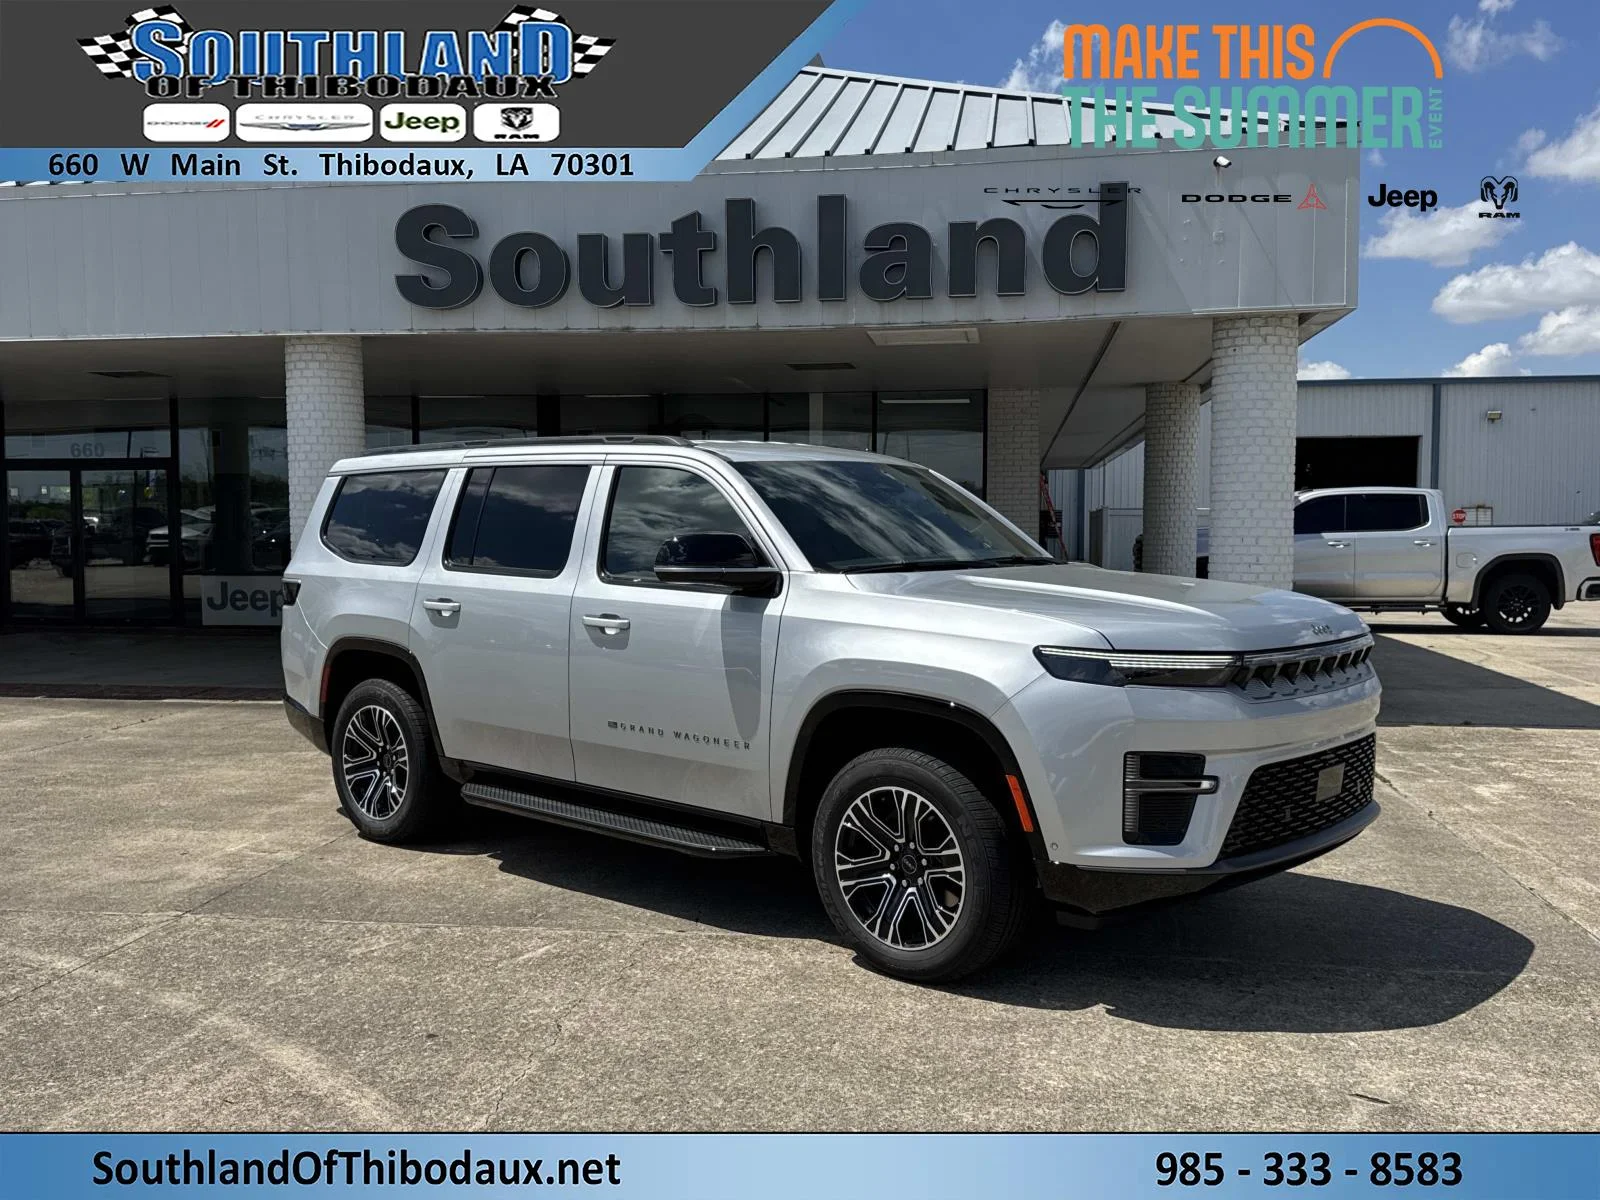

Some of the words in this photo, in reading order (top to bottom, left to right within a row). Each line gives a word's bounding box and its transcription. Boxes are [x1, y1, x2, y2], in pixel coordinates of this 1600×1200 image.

[394, 181, 1127, 308] Southland
[70, 442, 104, 458] 660
[620, 722, 664, 737] GRAND
[673, 730, 750, 750] WAGONEER
